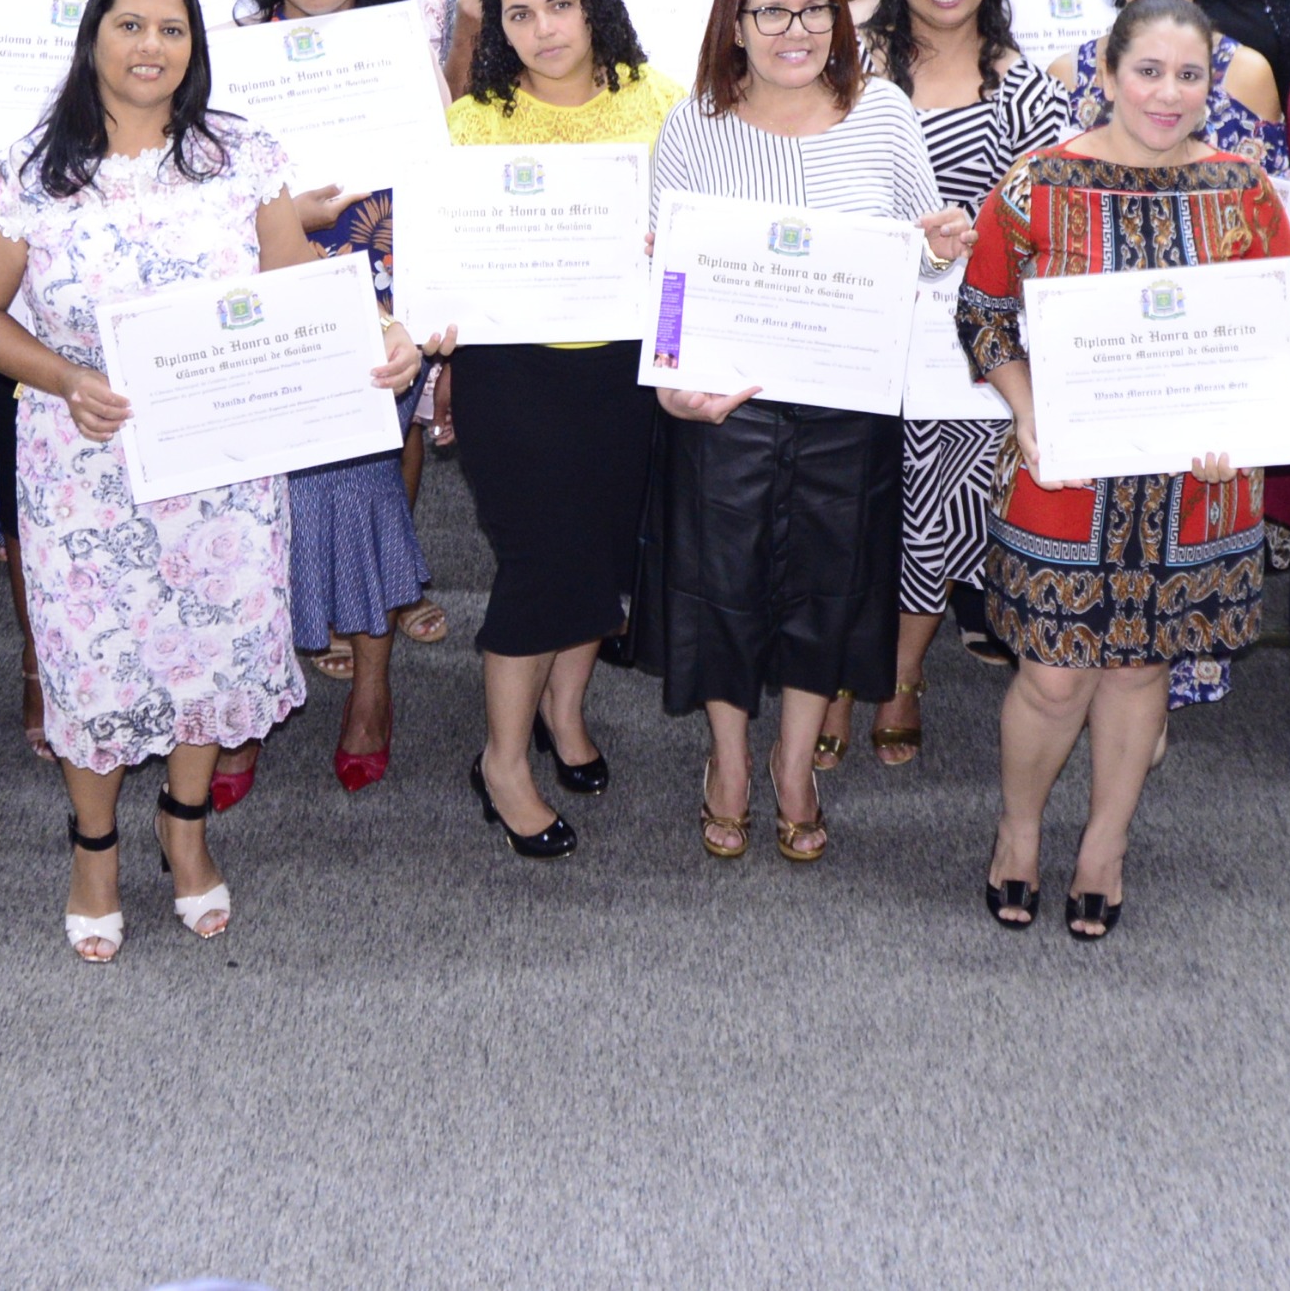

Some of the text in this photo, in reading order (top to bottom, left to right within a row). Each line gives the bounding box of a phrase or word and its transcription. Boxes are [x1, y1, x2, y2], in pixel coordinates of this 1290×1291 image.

[37, 36, 48, 45] de
[1057, 28, 1087, 37] Honra
[0, 49, 35, 59] Câmara
[228, 59, 392, 94] Diploma de Honra ao Mérito
[247, 94, 283, 105] Câmara
[287, 85, 329, 98] Municipal
[334, 81, 342, 89] de
[438, 204, 608, 219] Diploma de Honra ao Mérito
[496, 223, 540, 233] Municipal
[545, 223, 554, 231] de
[557, 222, 592, 231] Goiânia
[697, 254, 874, 287] Diploma de Honra ao Mérito
[712, 274, 750, 287] Câmara
[754, 279, 800, 294] Municipal
[805, 286, 814, 294] de
[818, 287, 854, 300] Goiânia
[761, 316, 788, 327] Maria
[154, 322, 337, 370] Diploma de Honra ao Mérito
[1073, 323, 1256, 350] Diploma de Honra ao Mérito
[176, 342, 322, 380] Câmara Municipal de Goiânia
[1093, 343, 1239, 363] Câmara Municipal de Goiânia
